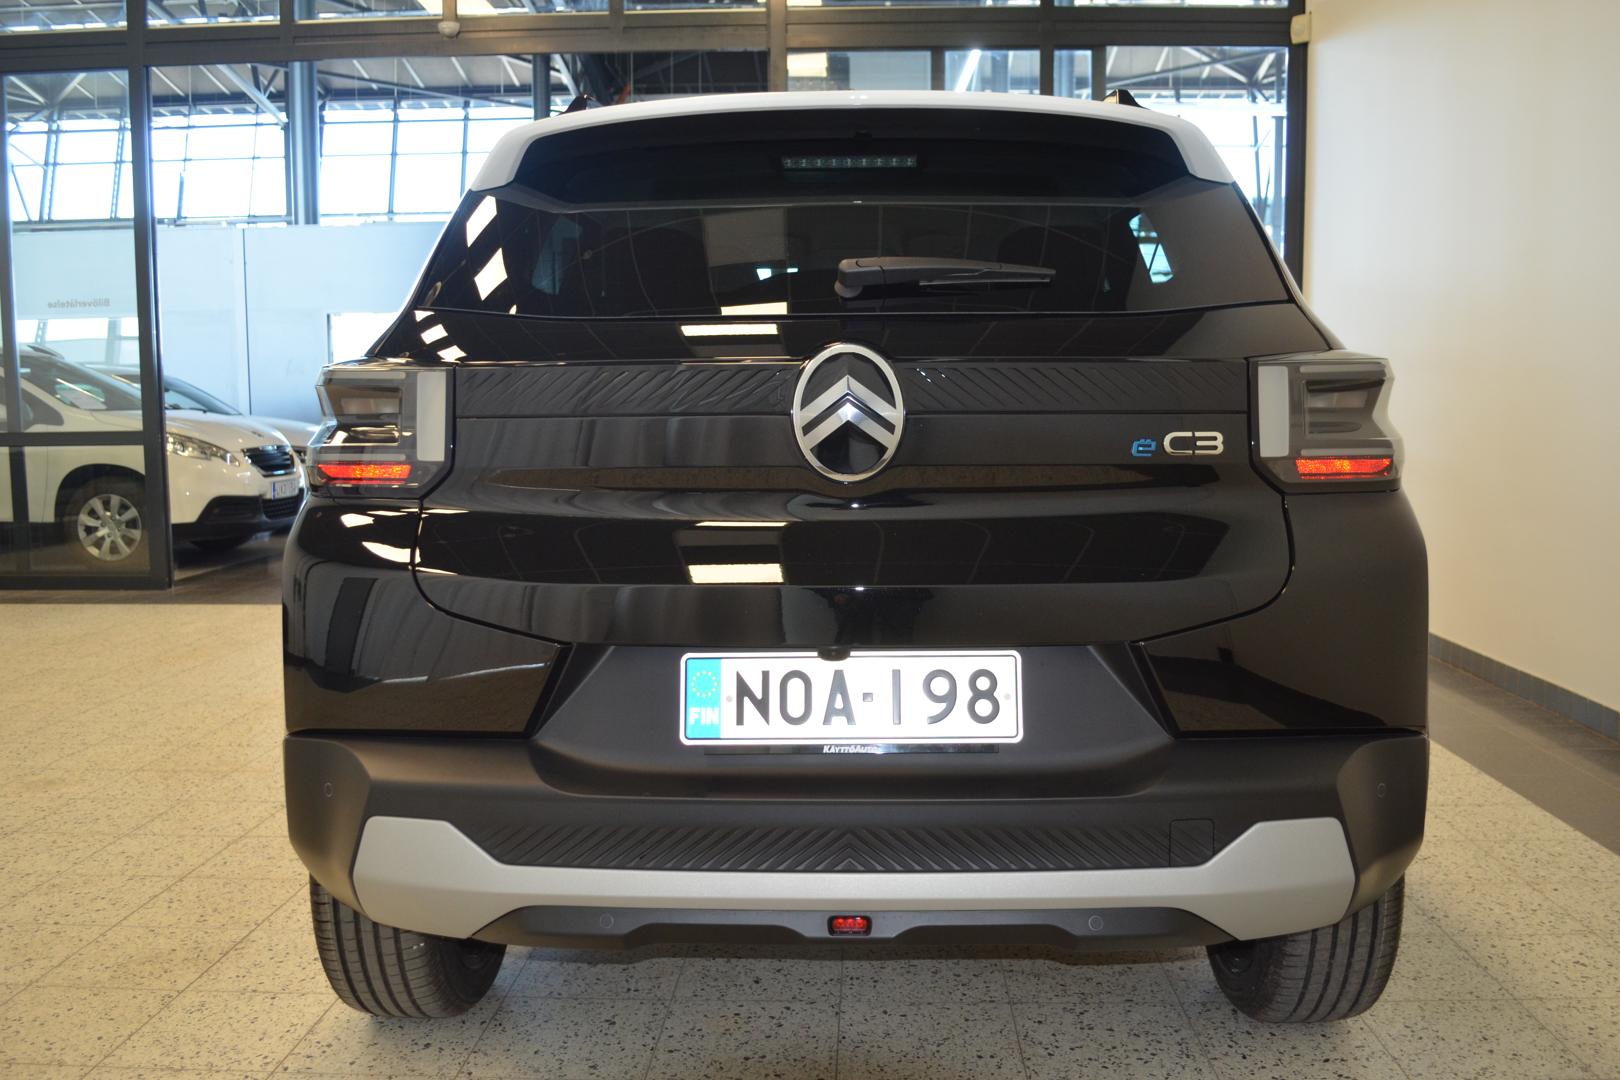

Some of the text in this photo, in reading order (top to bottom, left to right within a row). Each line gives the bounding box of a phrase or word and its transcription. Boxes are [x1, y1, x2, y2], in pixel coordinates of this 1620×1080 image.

[1163, 431, 1224, 456] C3
[736, 668, 1001, 726] NOA-198
[689, 707, 720, 725] FIN
